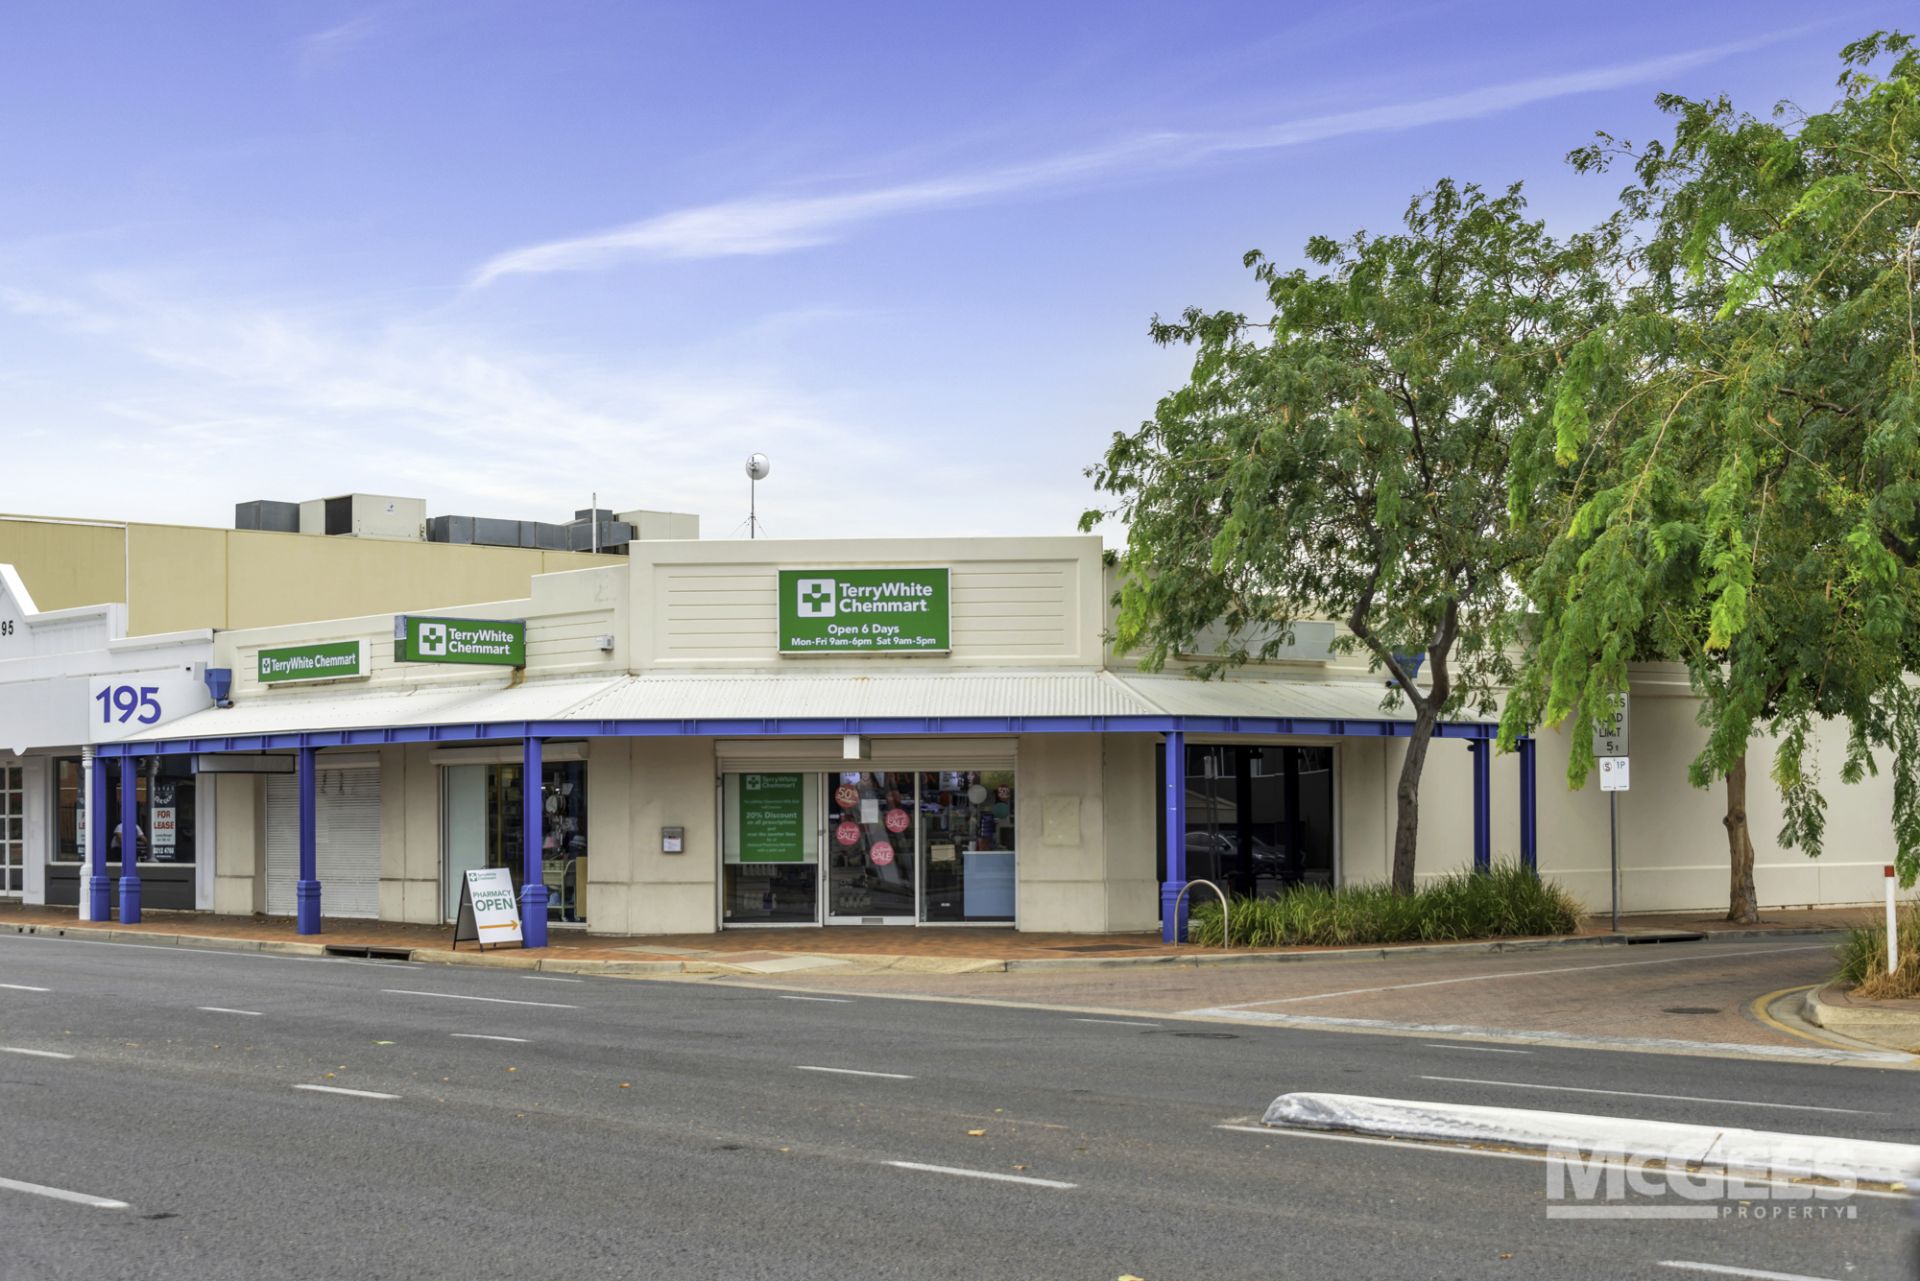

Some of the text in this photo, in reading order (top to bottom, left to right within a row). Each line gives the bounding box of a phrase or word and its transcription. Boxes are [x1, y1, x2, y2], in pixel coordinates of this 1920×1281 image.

[839, 582, 933, 600] TerryWhite
[839, 598, 928, 613] Chemmart
[449, 628, 514, 644] TerryWhite
[827, 624, 900, 636] Open 6 Days
[448, 641, 510, 655] Chemmart
[791, 637, 936, 647] Mon-Fri 9am-6pm Sat 9am-5pm
[272, 652, 356, 674] TerryWhite Chemmart
[95, 685, 162, 724] 195
[157, 810, 170, 819] FOR
[154, 821, 175, 829] LEASE
[837, 830, 857, 840] SALE
[473, 889, 511, 898] PHARMACY
[475, 898, 514, 911] OPEN
